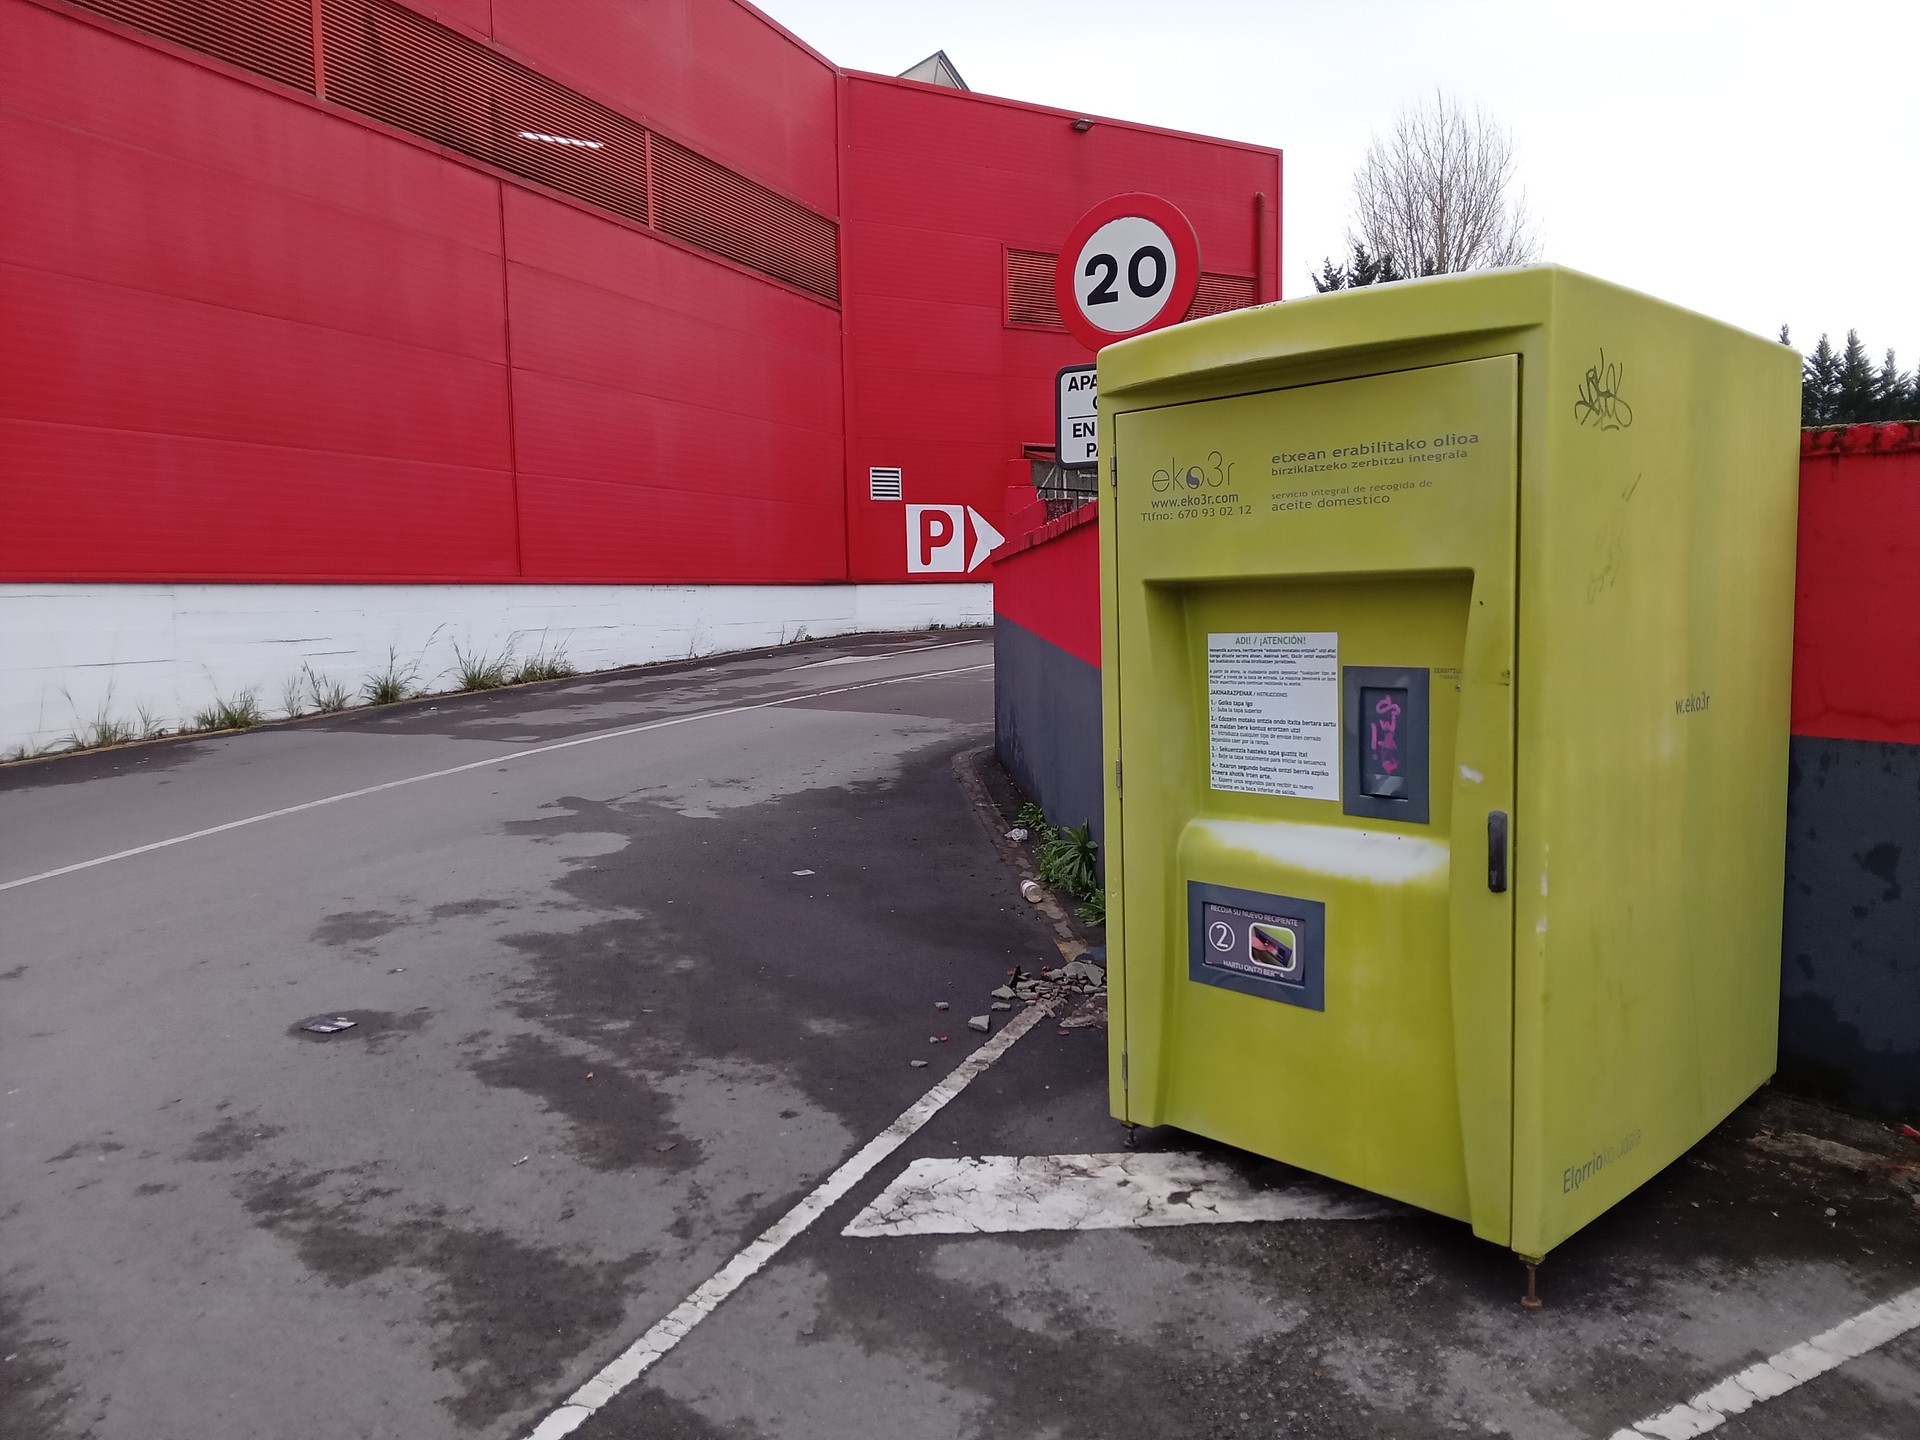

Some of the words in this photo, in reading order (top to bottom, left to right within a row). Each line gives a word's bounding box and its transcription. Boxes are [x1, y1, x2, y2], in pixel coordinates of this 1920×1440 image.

[1084, 246, 1167, 306] 20
[1073, 422, 1095, 438] EN
[1086, 443, 1098, 457] P
[1271, 449, 1327, 464] etxean
[1332, 437, 1426, 458] erabilitako
[1433, 432, 1480, 447] olioa
[1151, 451, 1235, 493] eko3r
[1271, 461, 1347, 476] birziklatzeko
[1351, 455, 1404, 470] zerbitzu
[1408, 448, 1468, 464] integrala
[1151, 491, 1239, 509] www.eko3r.com
[1271, 491, 1308, 500] servicio
[1311, 486, 1350, 497] integral
[1353, 485, 1367, 494] de
[1369, 480, 1416, 494] recogida
[1419, 479, 1433, 488] de
[1141, 510, 1173, 522] Tlfno:
[1177, 508, 1198, 520] 670
[1201, 507, 1215, 517] 93
[1219, 506, 1234, 517] 02
[1238, 504, 1252, 515] 12
[1271, 498, 1314, 512] aceite
[1317, 494, 1390, 508] domestico
[919, 509, 954, 566] P
[1260, 634, 1306, 646] ¡ATENCIÓN!
[1675, 691, 1710, 715] w.eko3r
[1210, 905, 1232, 914] RECOJA
[1242, 911, 1263, 920] NUEVO
[1264, 914, 1298, 926] RECIPIENTE
[1216, 925, 1228, 948] 2
[1223, 960, 1243, 969] HARTU
